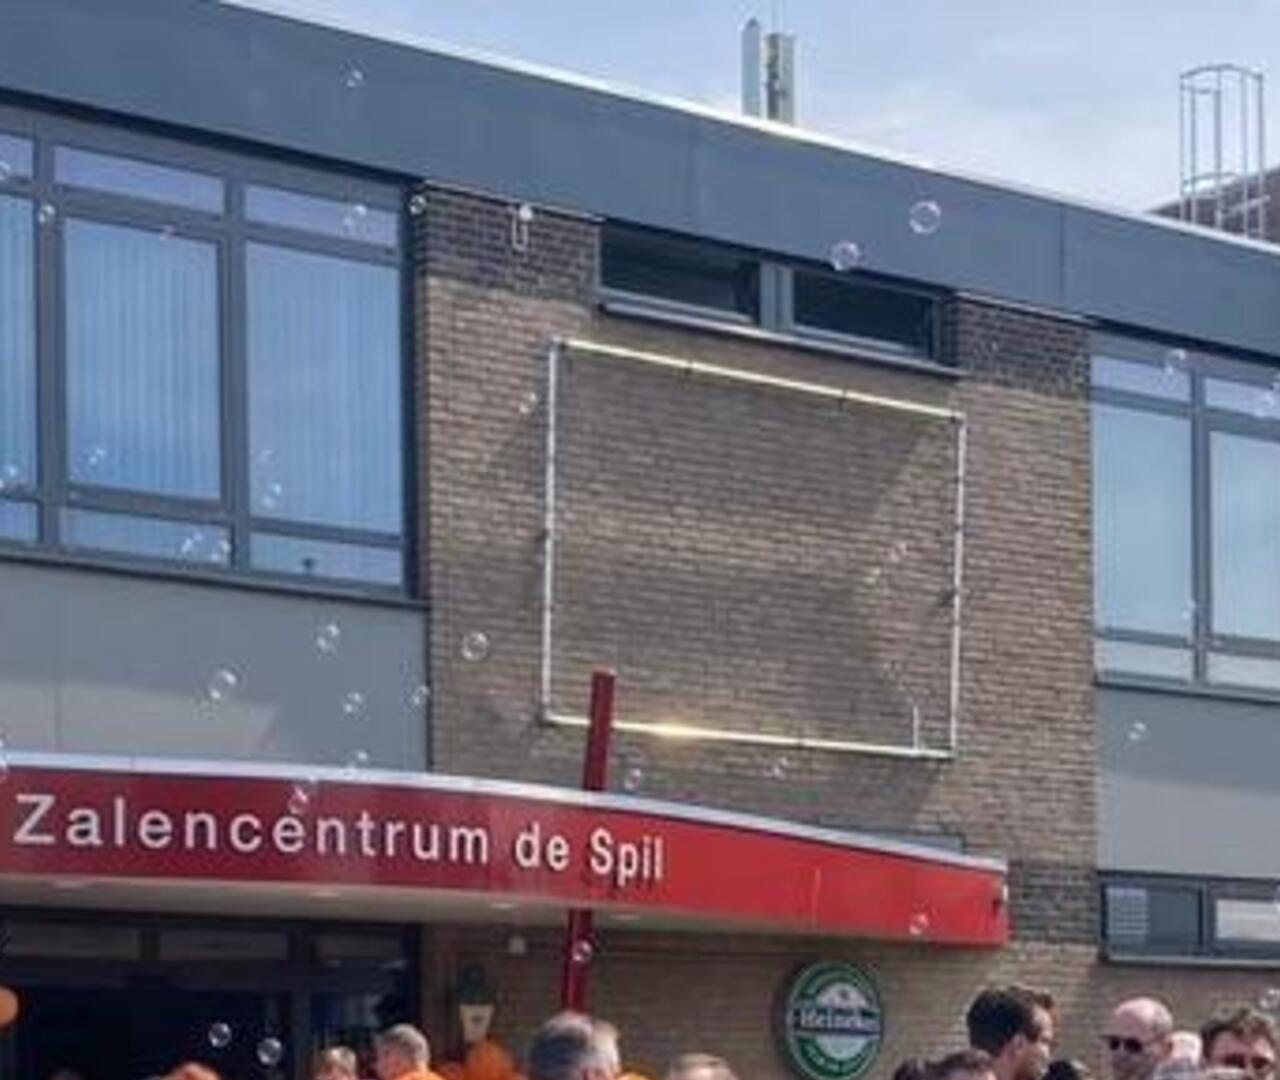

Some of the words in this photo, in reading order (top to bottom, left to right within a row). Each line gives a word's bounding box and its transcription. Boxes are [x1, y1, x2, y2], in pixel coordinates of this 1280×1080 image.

[13, 793, 489, 865] Zalencentrum
[515, 821, 570, 871] de
[589, 827, 663, 887] Spil
